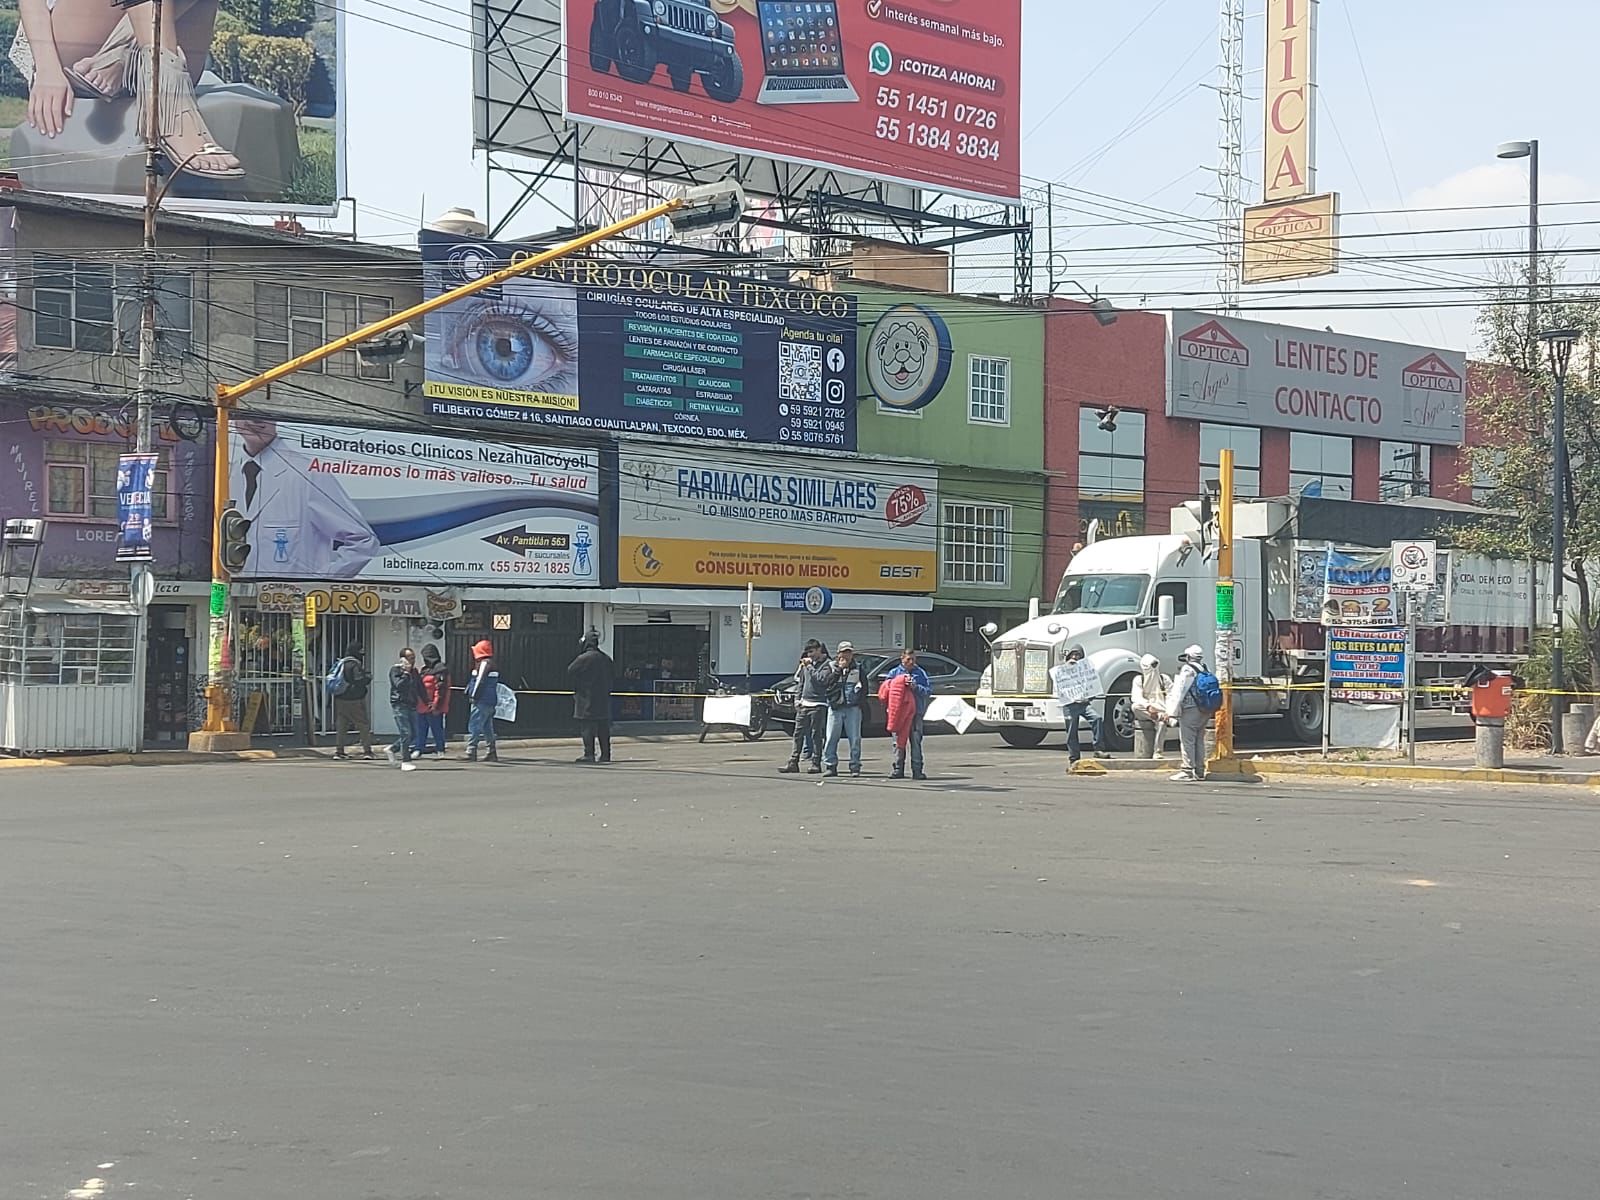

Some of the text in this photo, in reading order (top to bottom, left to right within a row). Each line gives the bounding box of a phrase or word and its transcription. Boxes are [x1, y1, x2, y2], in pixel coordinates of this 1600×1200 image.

[885, 7, 1005, 48] Interés semanal más bajo.
[900, 59, 996, 91] ¡COTIZA AHORA!
[876, 86, 997, 130] 55 1451 0726
[875, 116, 1000, 162] 55 1384 3834
[1262, 221, 1314, 236] OPTICA
[629, 268, 733, 304] OCULAR
[738, 282, 848, 319] TEXCOCO
[635, 297, 685, 314] OCULARES
[687, 306, 699, 316] DE
[700, 305, 721, 319] ALTA
[723, 308, 785, 326] ESPECIALIDAD
[816, 331, 825, 342] tu
[1187, 343, 1241, 363] OPTICA
[1275, 339, 1379, 380] LENTES DE
[1409, 374, 1455, 391] OPTICA
[481, 389, 494, 400] ES
[496, 391, 540, 404] NUESTRA
[1274, 386, 1382, 425] CONTACTO
[432, 403, 484, 418] FILIBERTO
[545, 415, 592, 428] SANTIAGO
[707, 426, 726, 438] EDO.
[790, 405, 845, 419] 59 5921 2782
[791, 418, 802, 428] 59
[803, 419, 823, 430] 5921
[791, 431, 844, 445] 55 8076 5761
[300, 433, 589, 471] Laboratorios Clínicos Nezahualcóyotl
[308, 457, 402, 478] Analizamos
[406, 464, 421, 479] lo
[425, 466, 456, 481] más
[530, 472, 546, 487] Tu
[550, 475, 588, 489] salud
[678, 468, 877, 511] FARMACIAS SIMILARES
[891, 490, 920, 516] 75%
[720, 505, 756, 519] MISMO
[759, 507, 788, 520] PERO
[790, 510, 814, 522] MAS
[496, 535, 567, 547] Av. Pantitlán 563
[534, 551, 570, 560] sucursales
[383, 558, 570, 574] labclineza.com.mx 55 5732 1825
[695, 560, 850, 578] CONSULTORIO MEDICO
[879, 565, 923, 578] BEST
[330, 584, 402, 594] COMPRO
[308, 589, 380, 615] ORO
[381, 598, 422, 616] PLATA
[1331, 641, 1348, 651] LOS
[1348, 642, 1375, 651] REYES
[1376, 642, 1387, 652] LA
